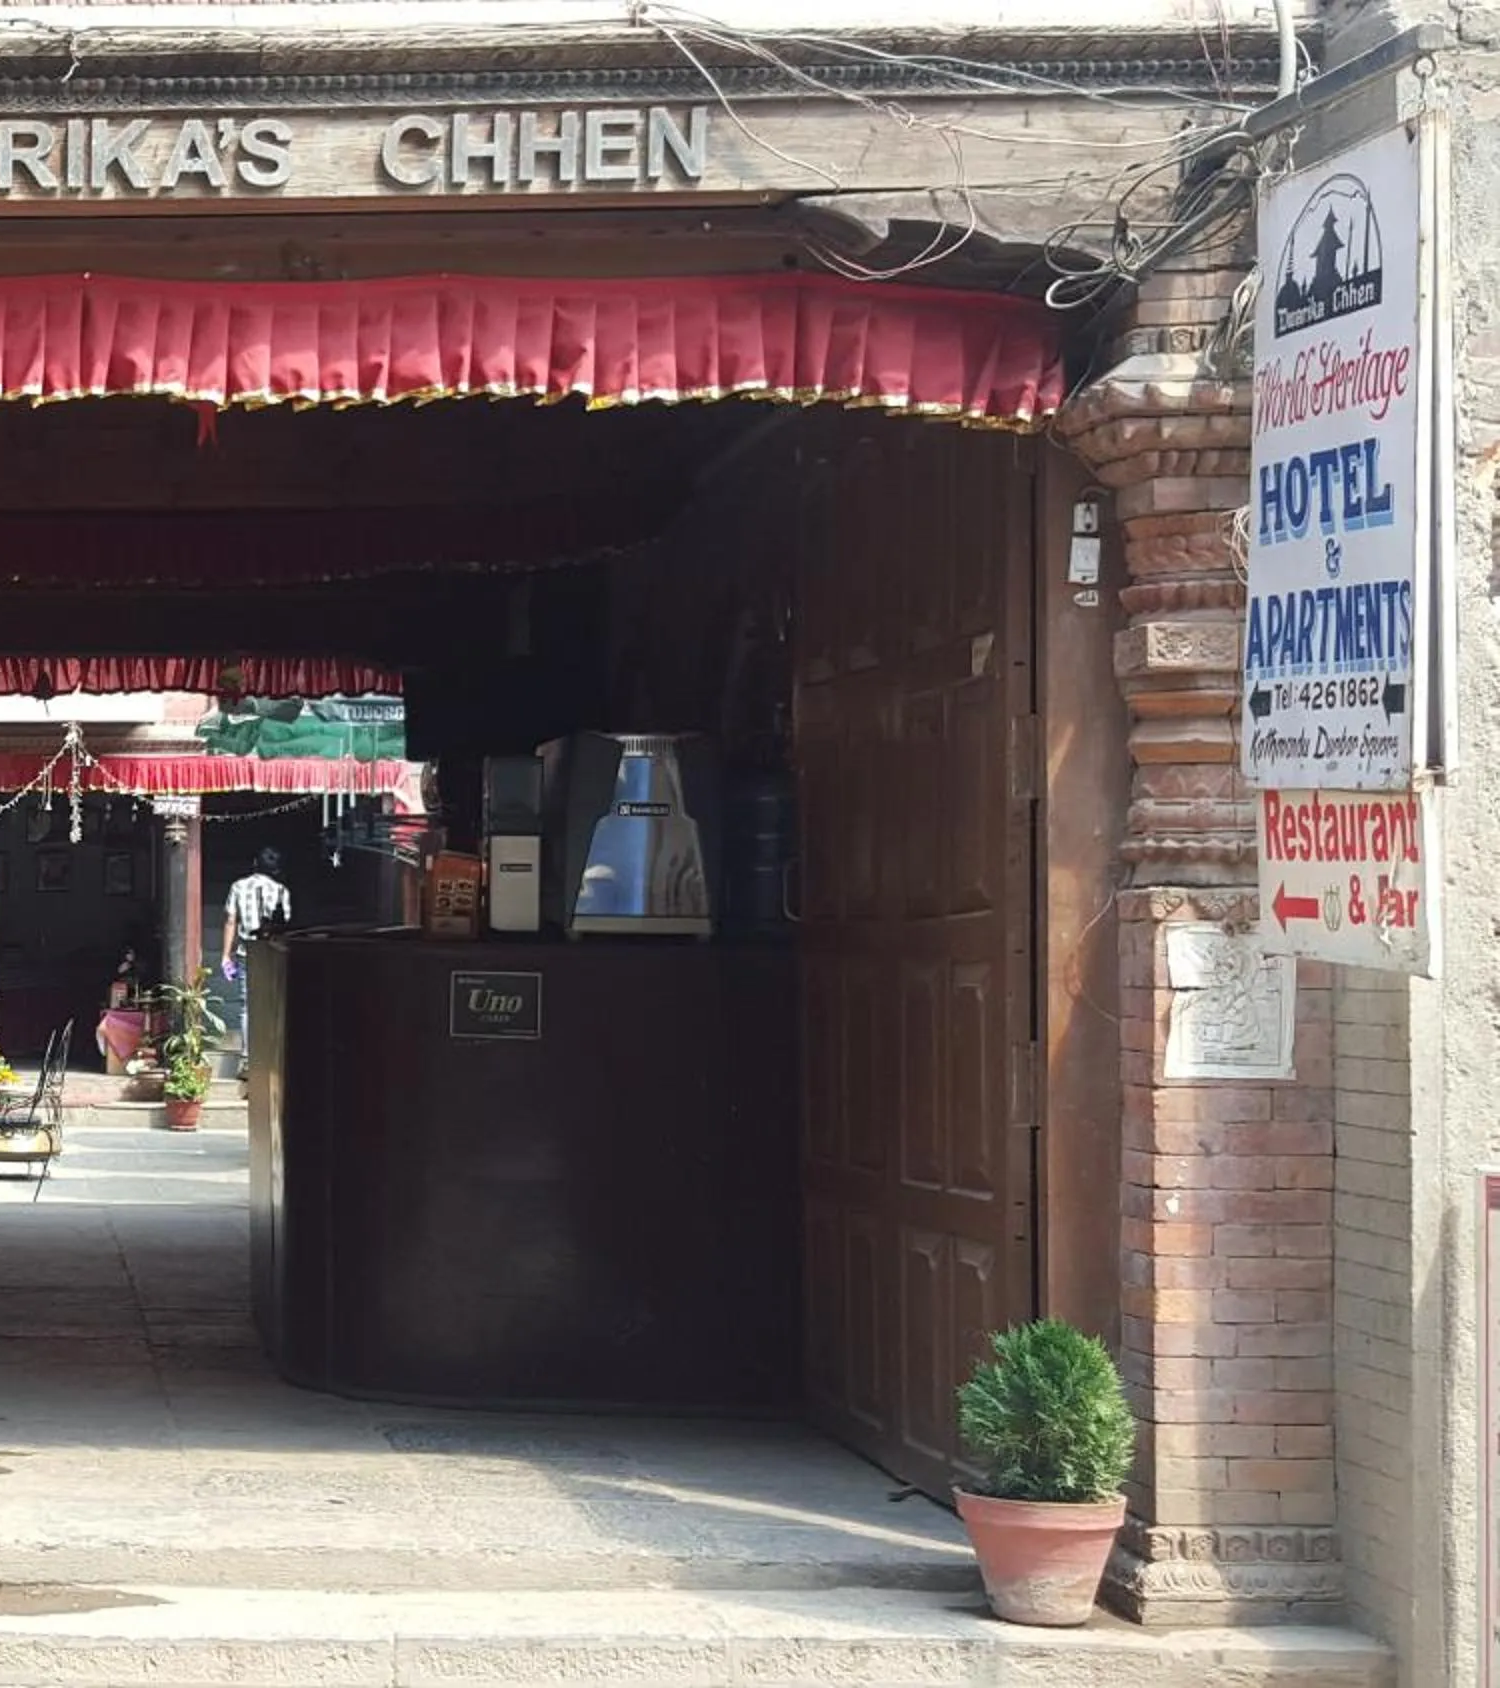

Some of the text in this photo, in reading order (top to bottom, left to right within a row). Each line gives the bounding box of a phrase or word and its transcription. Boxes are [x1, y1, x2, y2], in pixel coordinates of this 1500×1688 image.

[382, 107, 708, 187] CHHEN
[1277, 282, 1375, 331] Dwarika Chhen
[1255, 327, 1410, 436] World Heritage
[1259, 437, 1393, 543] HOTEL
[1325, 537, 1342, 575] &
[1246, 579, 1411, 674] APARTMENTS
[1264, 783, 1419, 863] Restaurant
[1348, 874, 1366, 925] &
[468, 989, 522, 1013] Uno
